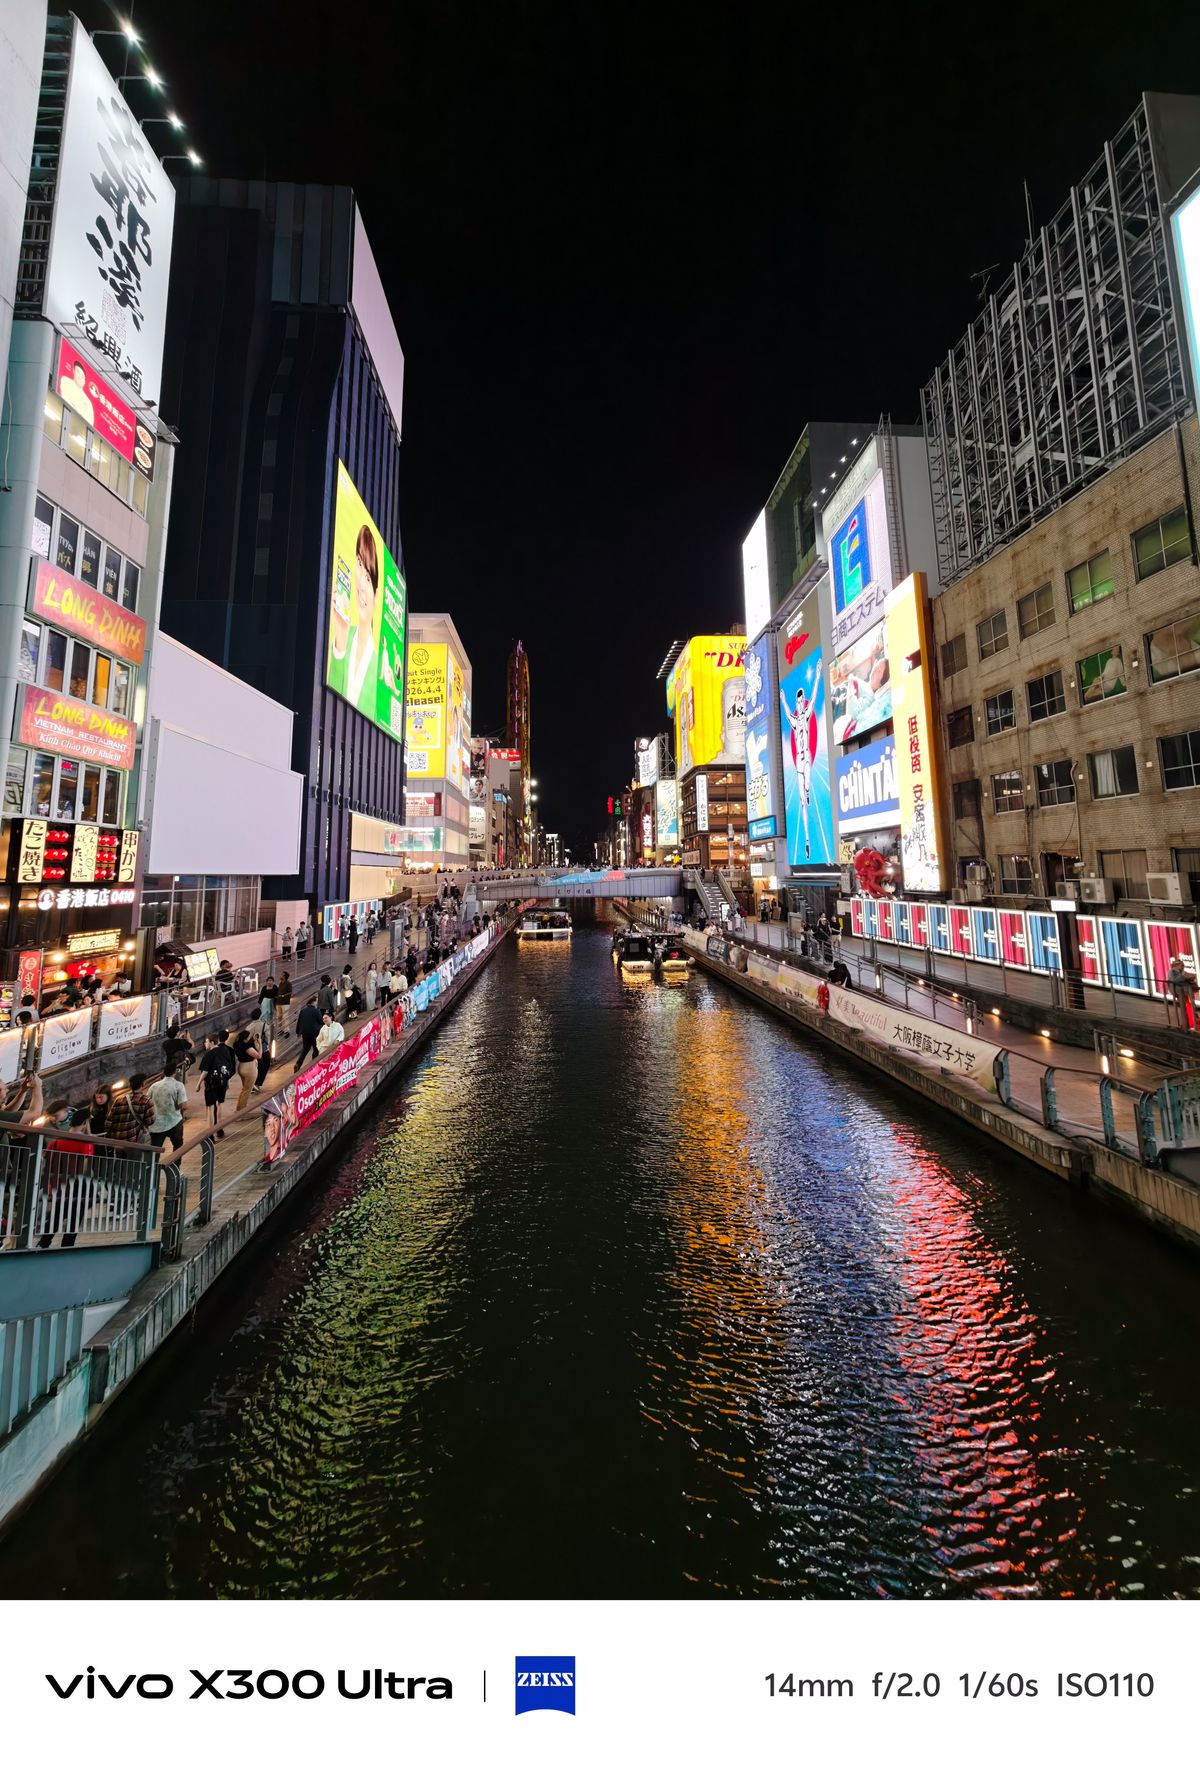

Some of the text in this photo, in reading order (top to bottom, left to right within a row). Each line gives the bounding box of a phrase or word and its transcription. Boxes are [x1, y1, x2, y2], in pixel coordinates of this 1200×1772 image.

[43, 578, 141, 649] LONG DINH
[831, 584, 887, 647] 日商エステム
[420, 668, 442, 676] Single
[34, 717, 127, 751] VIETNAM RESTAURANT
[35, 696, 129, 740] LONG DINH
[22, 821, 44, 881] たこ焼き
[121, 832, 138, 881] 串かつ
[56, 888, 135, 909] 香港飯店 0410
[50, 1038, 83, 1055] Gliglow
[107, 1022, 144, 1036] Gliglow
